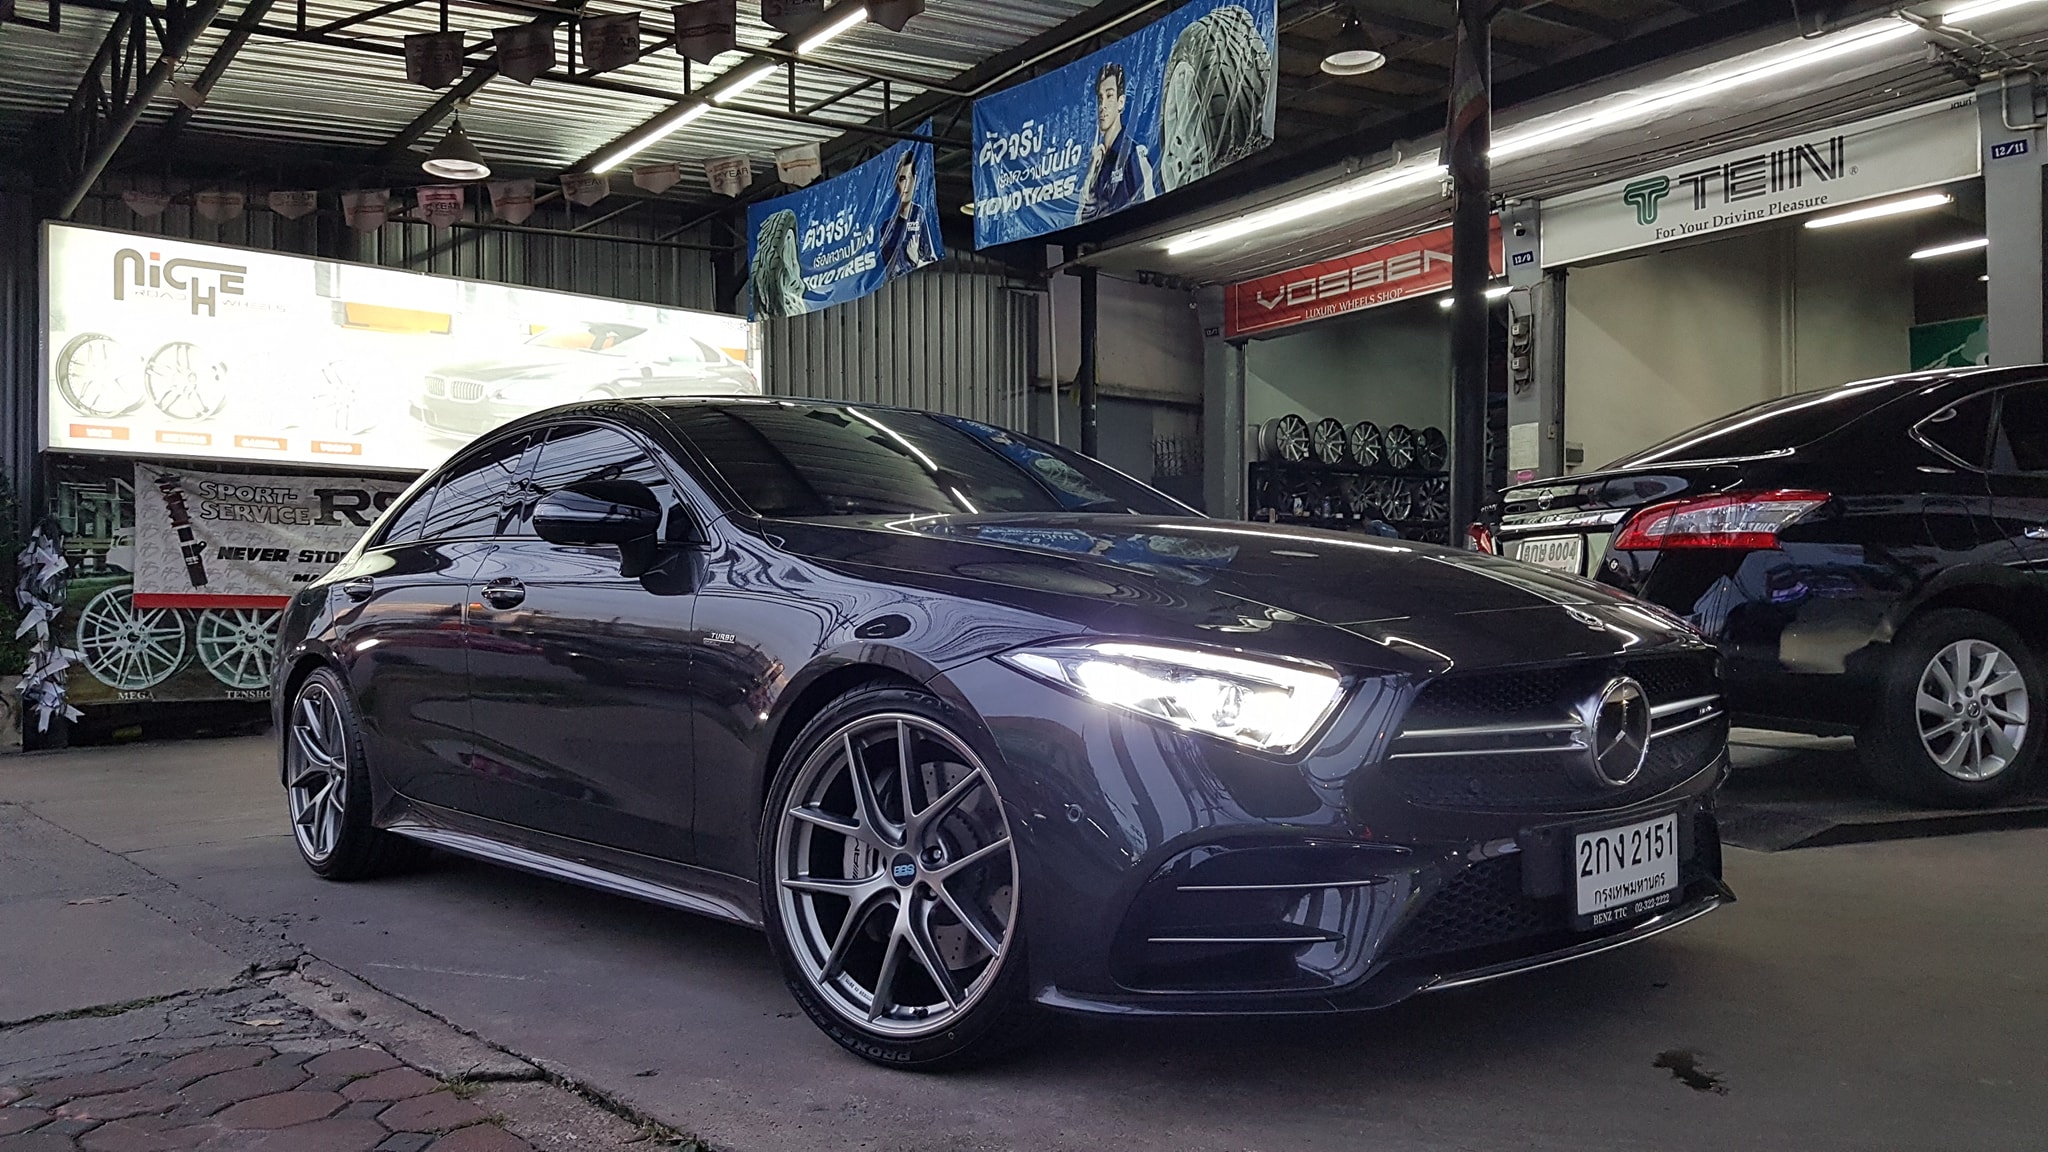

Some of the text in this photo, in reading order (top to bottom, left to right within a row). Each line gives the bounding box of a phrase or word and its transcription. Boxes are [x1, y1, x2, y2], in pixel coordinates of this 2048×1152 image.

[980, 119, 1044, 168] ตัวจริง
[1994, 142, 2025, 157] 12/11
[723, 166, 749, 178] YEAR
[1679, 135, 1844, 211] TEIN
[1655, 195, 1828, 240] For Your Driving Pleasure
[1256, 249, 1453, 310] VOSSEN
[1305, 287, 1403, 319] LUXURY WHEELS SHOP
[200, 480, 298, 505] SPORT-
[200, 500, 311, 526] SERVICE
[217, 546, 290, 563] NEVER
[298, 549, 348, 564] STO
[711, 632, 736, 642] TURBO
[1580, 820, 1673, 878] 2กง 2151
[893, 863, 916, 877] BBS
[1593, 910, 1613, 926] BENZ
